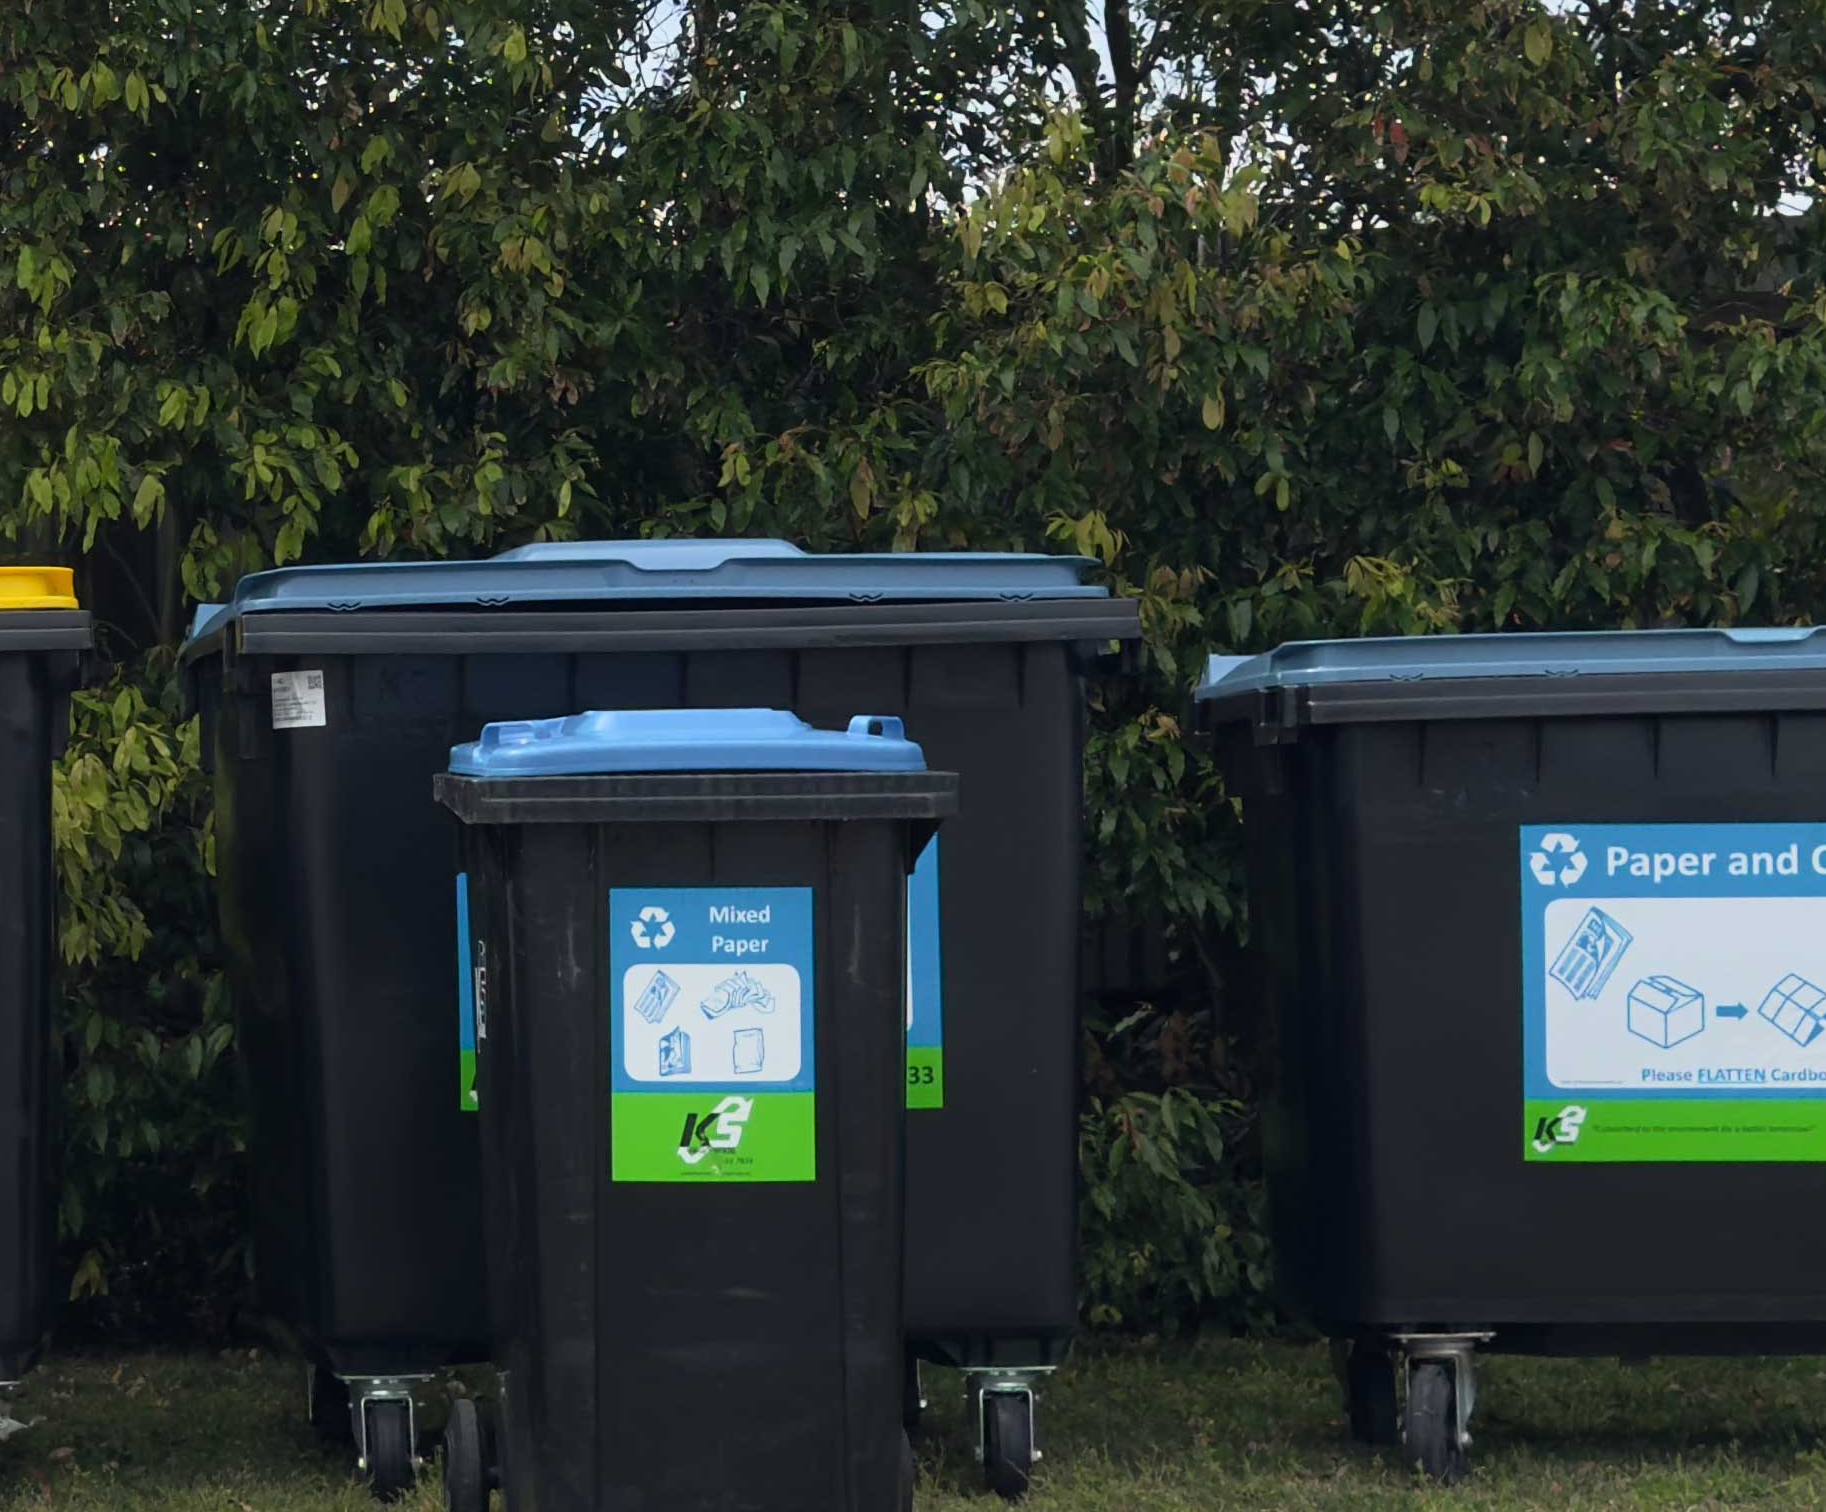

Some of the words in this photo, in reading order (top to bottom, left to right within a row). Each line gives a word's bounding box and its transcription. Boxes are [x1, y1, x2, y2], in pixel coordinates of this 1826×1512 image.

[1607, 846, 1717, 883] Paper
[1728, 843, 1798, 875] and
[709, 905, 770, 923] Mixed
[712, 936, 769, 956] Paper
[908, 1066, 934, 1085] 33
[1642, 1068, 1692, 1081] Please
[1698, 1068, 1766, 1083] FLATTEN
[677, 1096, 754, 1164] KS
[1532, 1105, 1588, 1153] KS
